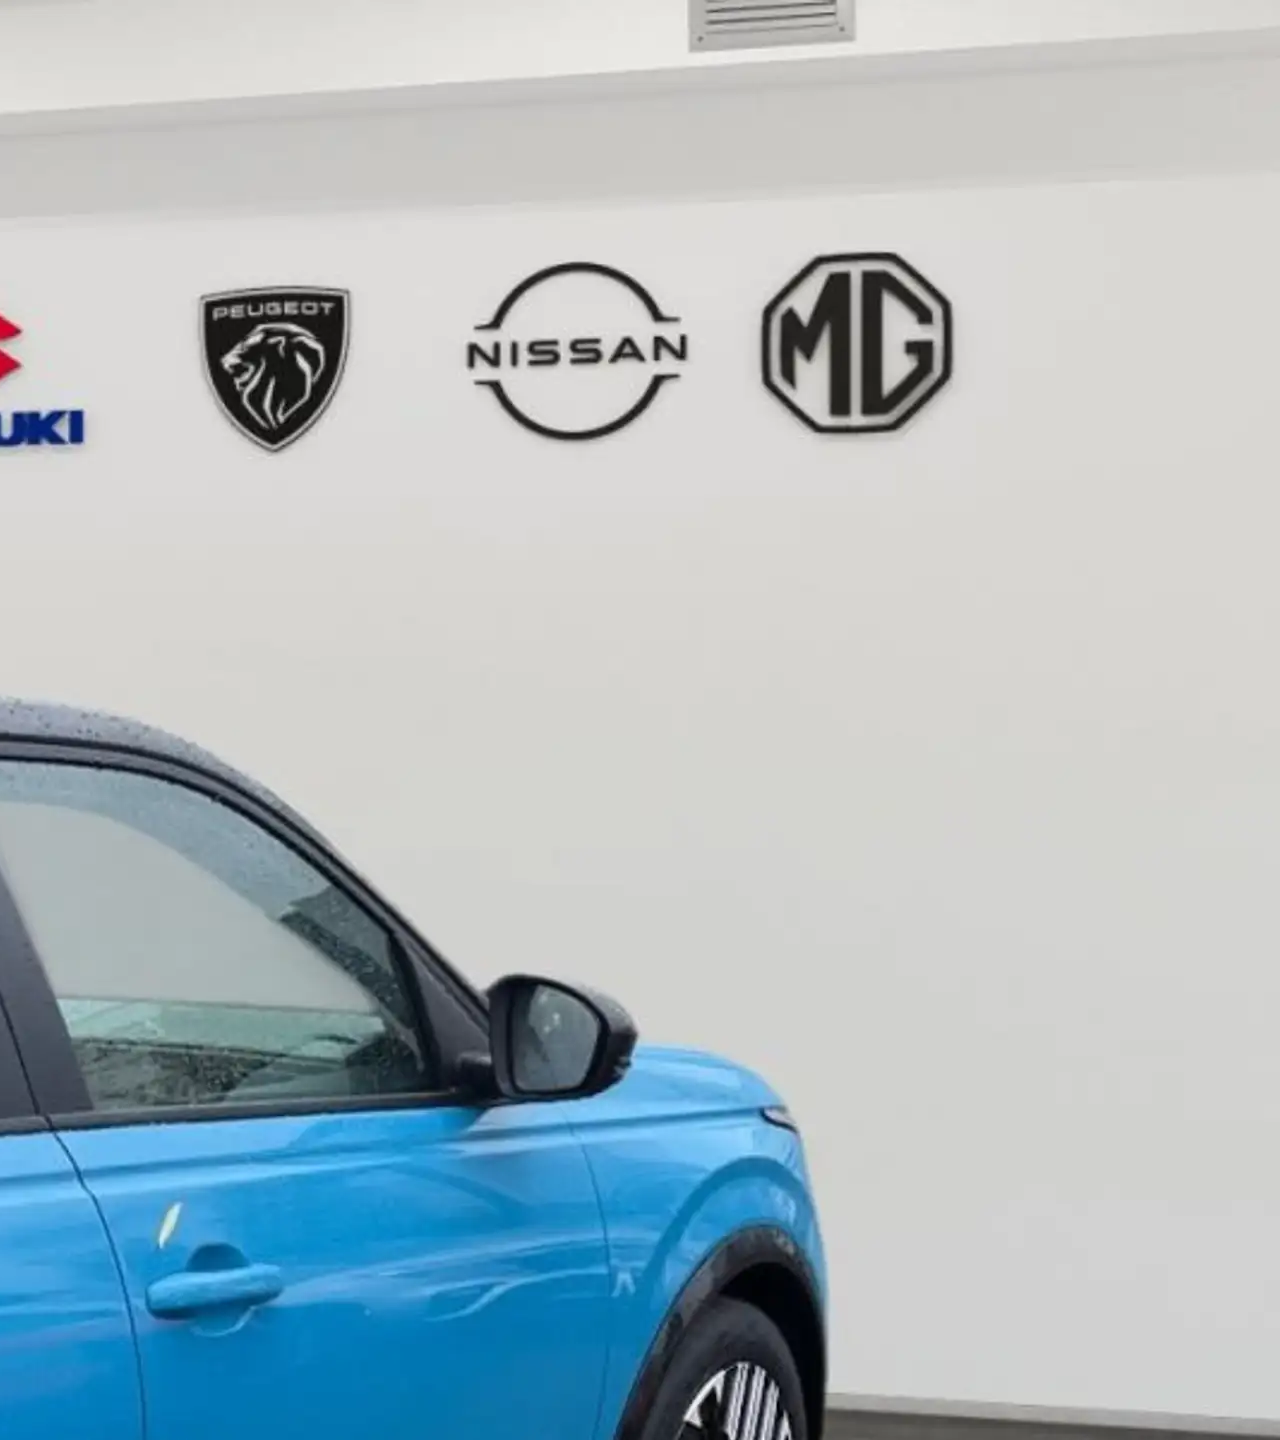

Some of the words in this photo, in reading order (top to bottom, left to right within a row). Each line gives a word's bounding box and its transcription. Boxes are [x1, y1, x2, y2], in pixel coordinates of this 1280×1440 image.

[212, 301, 337, 322] PEUGEOT
[467, 332, 689, 370] NISSAN
[780, 269, 934, 416] MG
